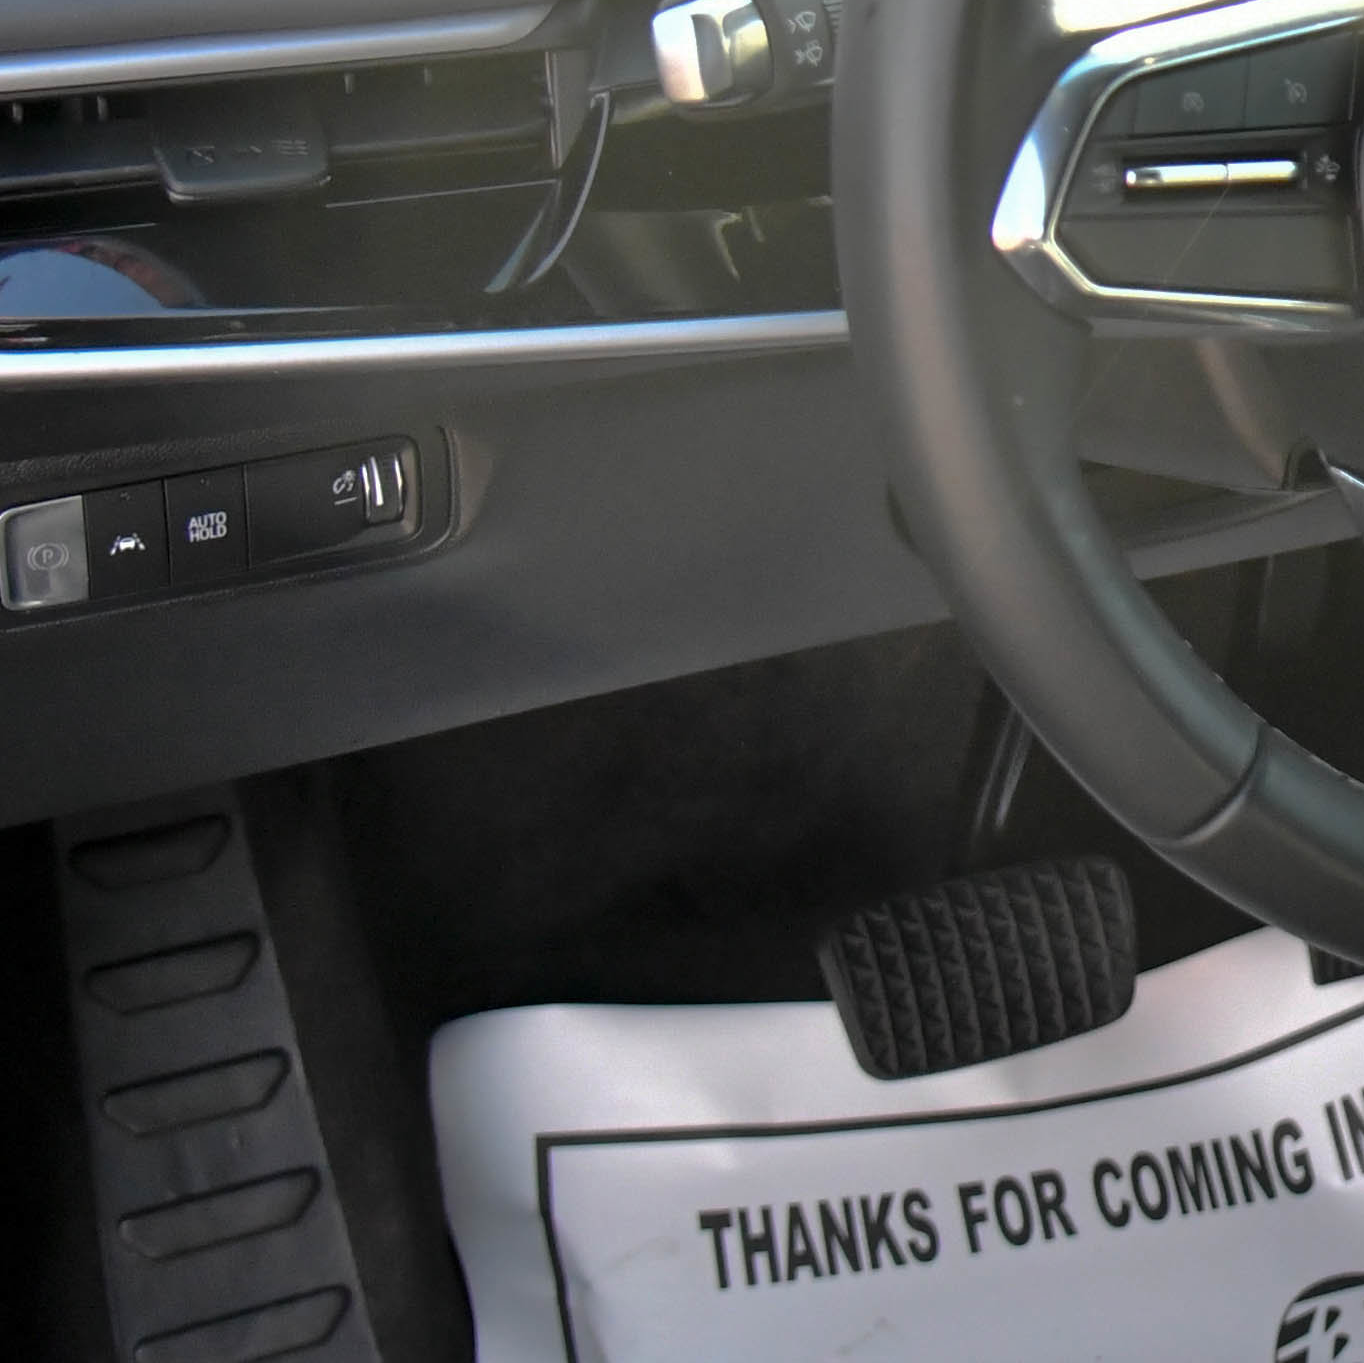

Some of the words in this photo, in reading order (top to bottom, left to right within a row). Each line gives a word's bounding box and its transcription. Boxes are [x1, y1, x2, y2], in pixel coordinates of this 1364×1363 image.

[189, 511, 228, 529] AUTO
[189, 524, 228, 544] HOLD
[698, 1188, 940, 1290] THANKS
[957, 1168, 1078, 1255] FOR
[1092, 1118, 1315, 1229] COMING
